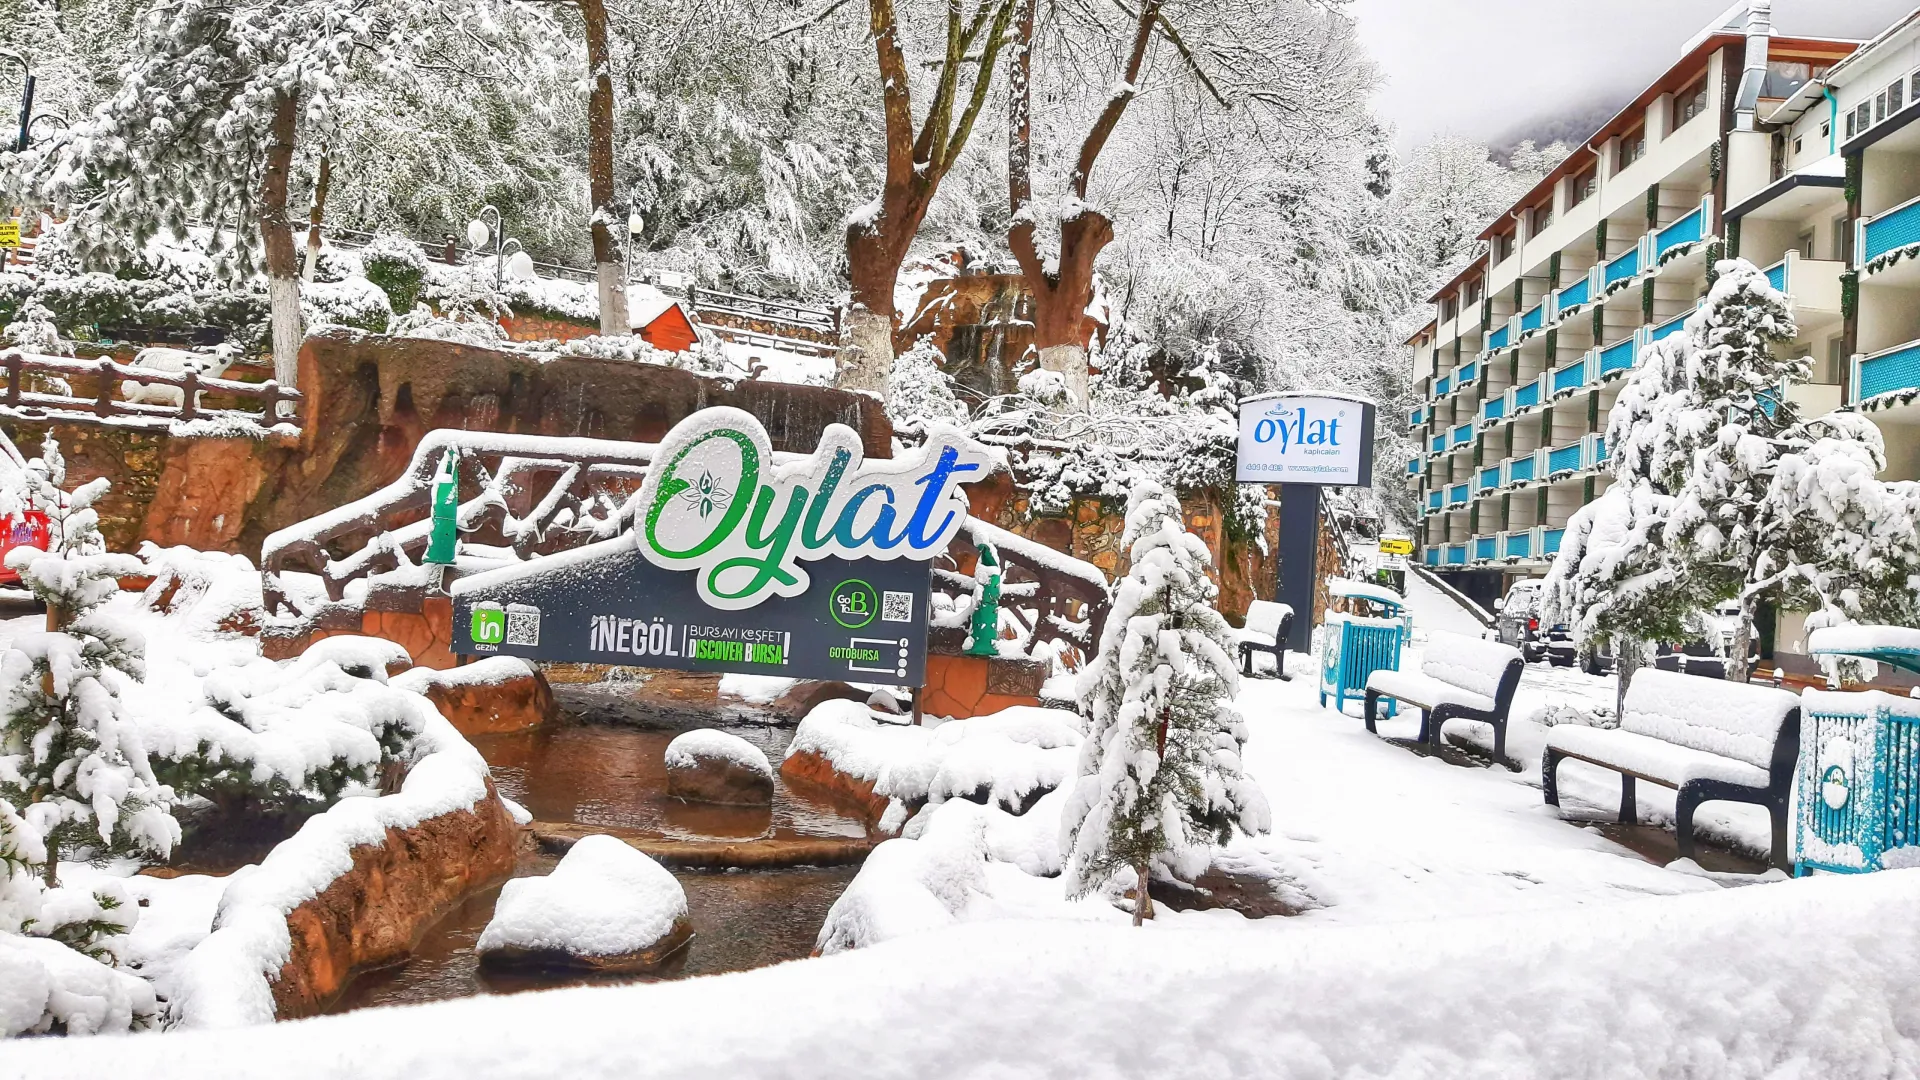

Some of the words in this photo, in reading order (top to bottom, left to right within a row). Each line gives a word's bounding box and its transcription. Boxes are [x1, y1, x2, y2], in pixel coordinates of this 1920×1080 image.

[1254, 408, 1343, 455] oylat
[1288, 465, 1349, 473] www.oylat.com
[645, 428, 980, 599] Oylat
[837, 594, 851, 604] Go
[851, 591, 867, 613] B
[840, 604, 851, 613] To
[590, 614, 679, 656] İNEGÖL
[475, 643, 498, 652] GEZİN
[688, 638, 743, 661] DISCOVER
[829, 647, 880, 661] GOTOBURSA
